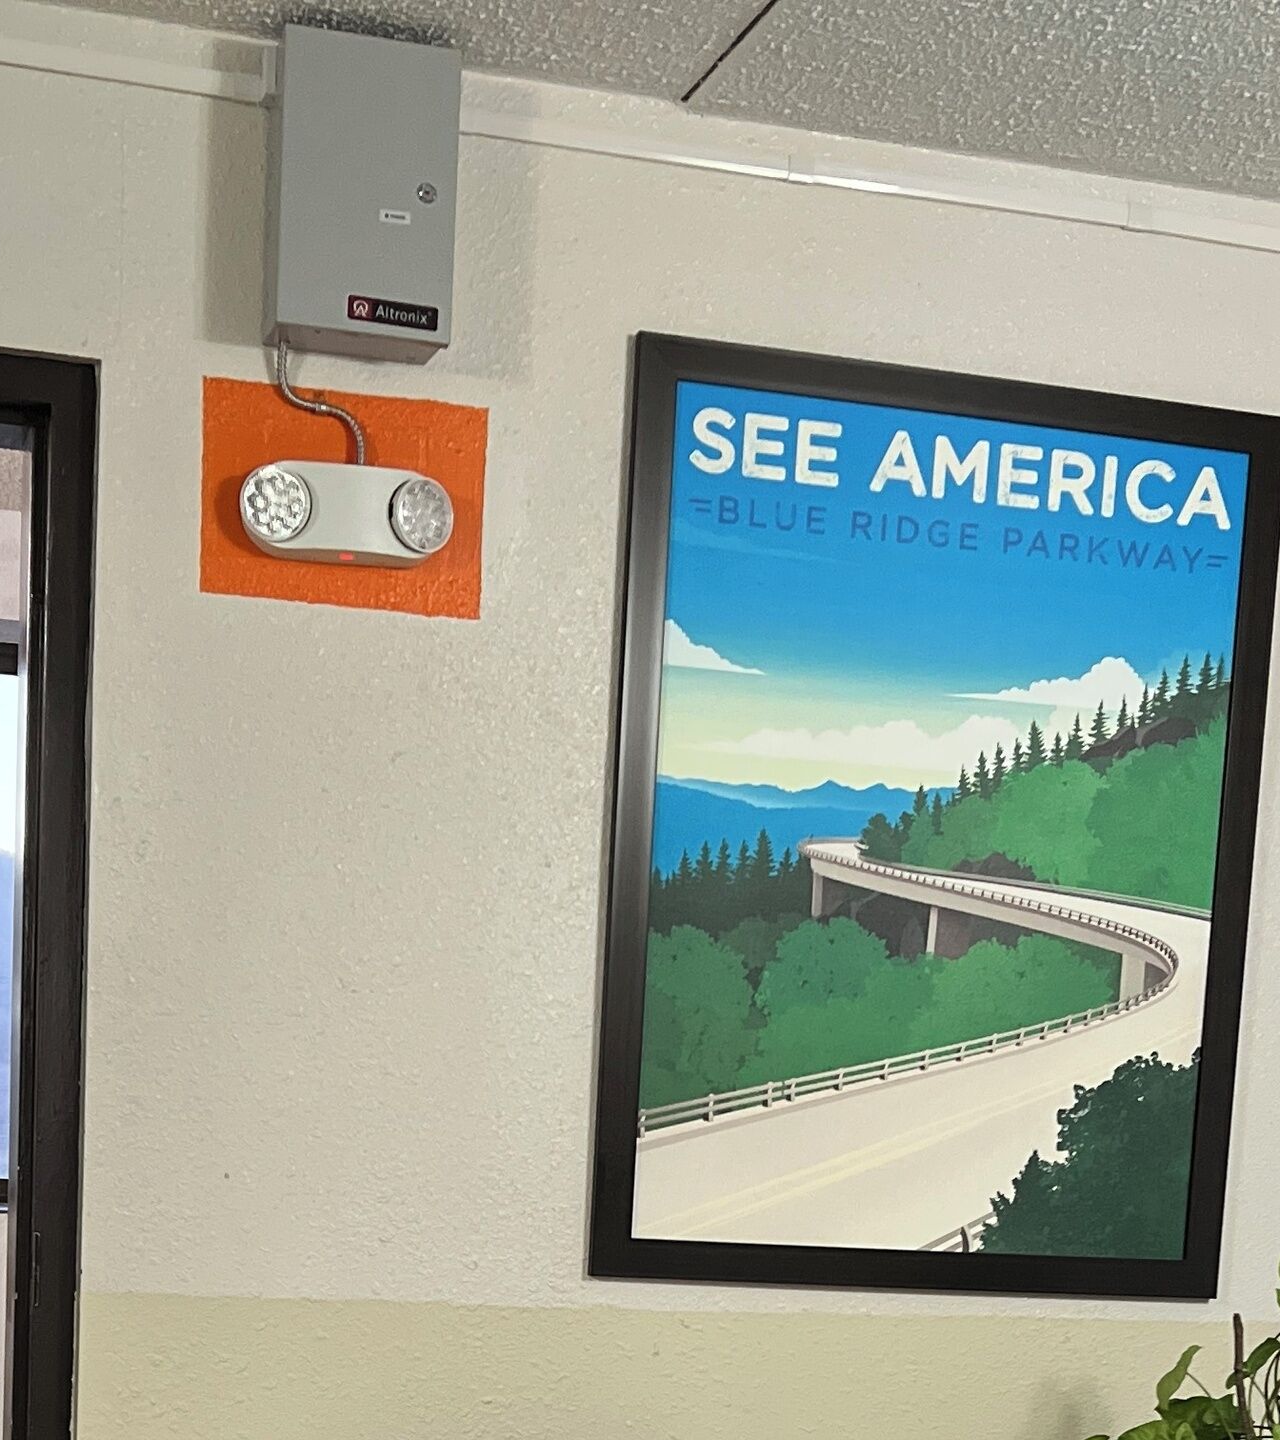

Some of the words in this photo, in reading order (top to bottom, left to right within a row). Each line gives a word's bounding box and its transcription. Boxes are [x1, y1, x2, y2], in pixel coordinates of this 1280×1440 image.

[375, 304, 428, 325] Altronix
[689, 406, 843, 488] SEE
[870, 430, 1232, 530] AMERICA
[717, 495, 827, 536] BLUE
[850, 511, 979, 551] RIDGE
[1002, 527, 1204, 574] PARKWAY
